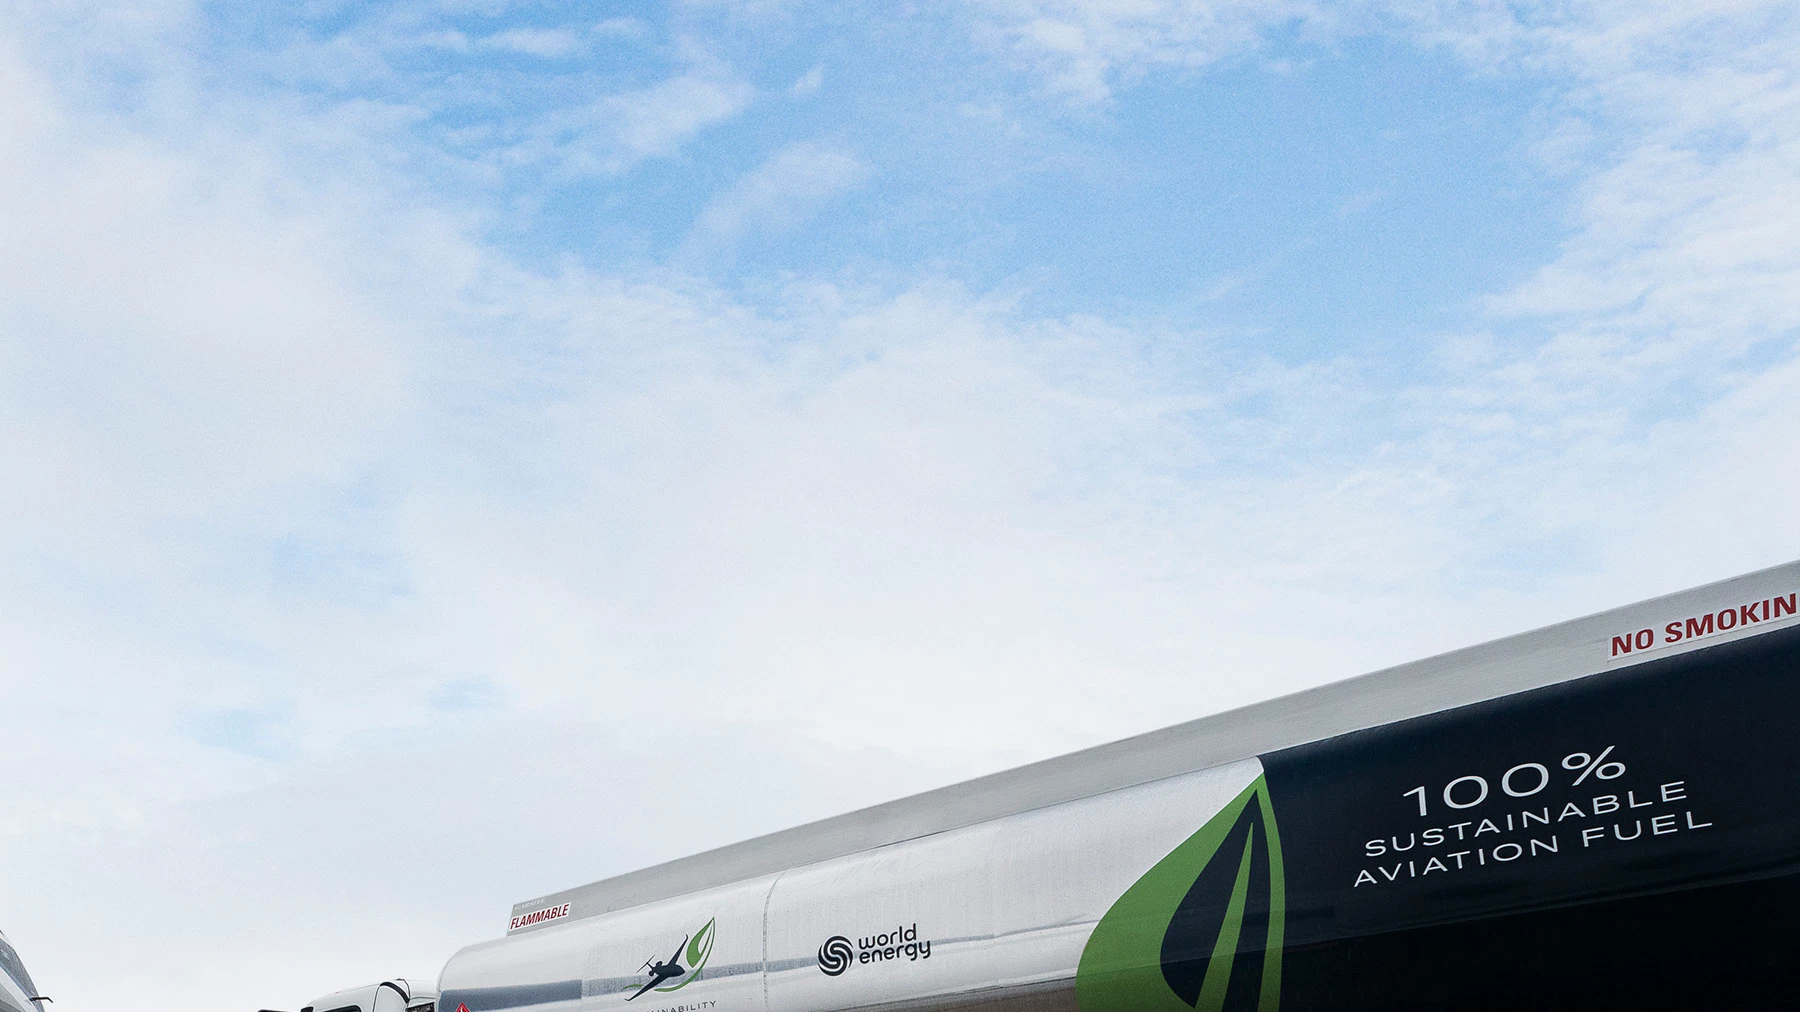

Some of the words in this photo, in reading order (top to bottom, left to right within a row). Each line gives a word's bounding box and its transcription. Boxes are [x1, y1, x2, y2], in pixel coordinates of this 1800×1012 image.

[1611, 628, 1654, 657] NO
[1664, 592, 1800, 644] SMOKIN
[1402, 745, 1626, 817] 100%
[1353, 835, 1559, 888] AVIATION
[1582, 811, 1713, 848] FUEL
[1364, 780, 1688, 857] SUSTAINABLE
[509, 904, 570, 930] FLAMMABLE
[858, 922, 917, 950] world
[858, 940, 932, 964] energy
